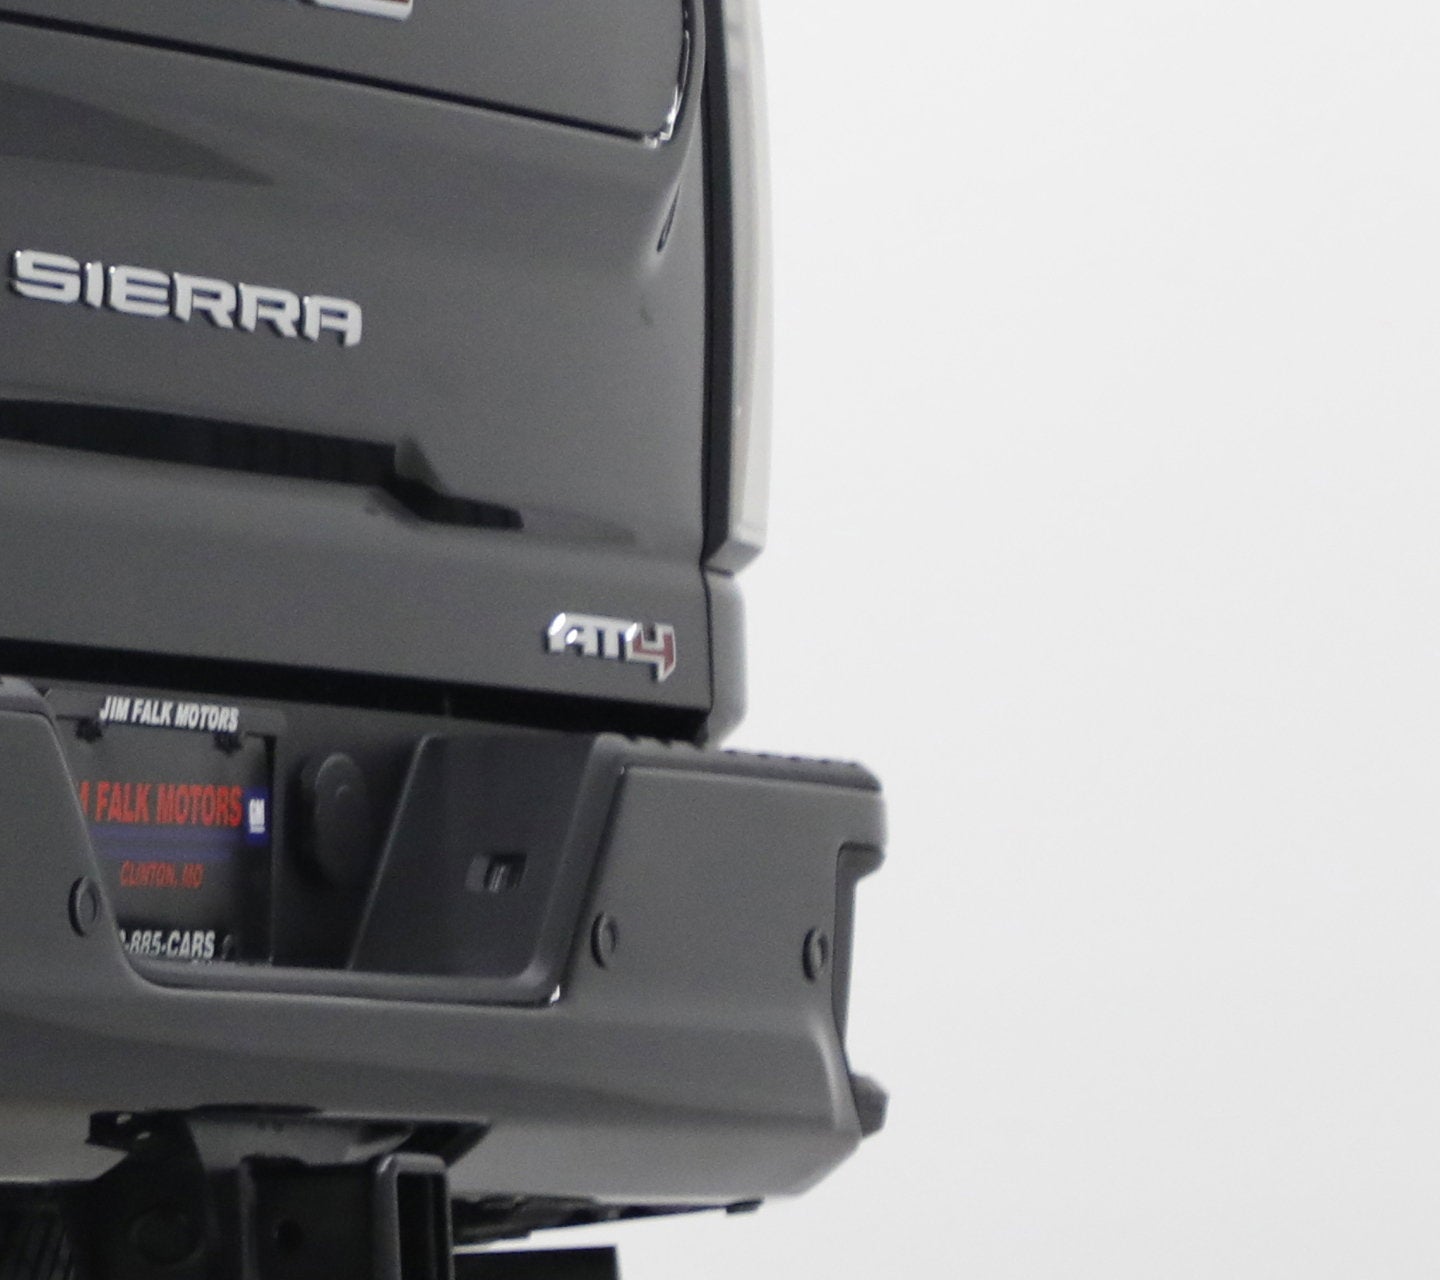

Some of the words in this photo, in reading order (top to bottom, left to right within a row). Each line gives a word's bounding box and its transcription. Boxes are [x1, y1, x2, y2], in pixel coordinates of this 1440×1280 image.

[11, 248, 363, 348] SIERRA
[547, 612, 677, 683] AT4
[99, 695, 131, 721] JIM
[131, 698, 173, 726] FALK
[175, 702, 240, 733] MOTORS
[95, 781, 151, 824] FALK
[156, 783, 244, 828] MOTORS
